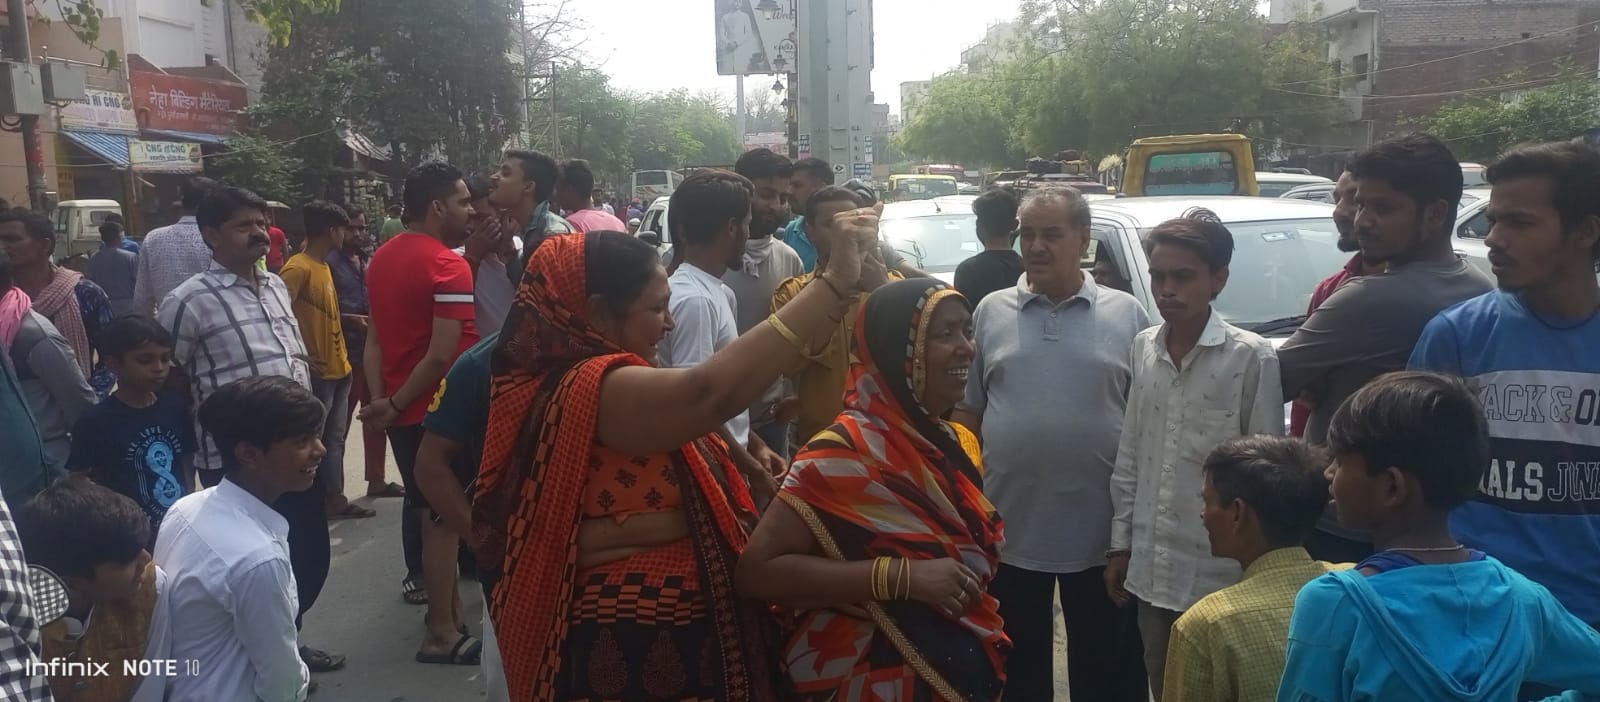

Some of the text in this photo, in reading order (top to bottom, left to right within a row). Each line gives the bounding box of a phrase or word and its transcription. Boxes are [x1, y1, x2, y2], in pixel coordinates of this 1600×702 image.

[104, 95, 120, 108] CNG
[149, 84, 168, 109] नेहा
[145, 143, 161, 152] CNG
[170, 144, 186, 153] CNG
[1479, 384, 1600, 426] ACK & O
